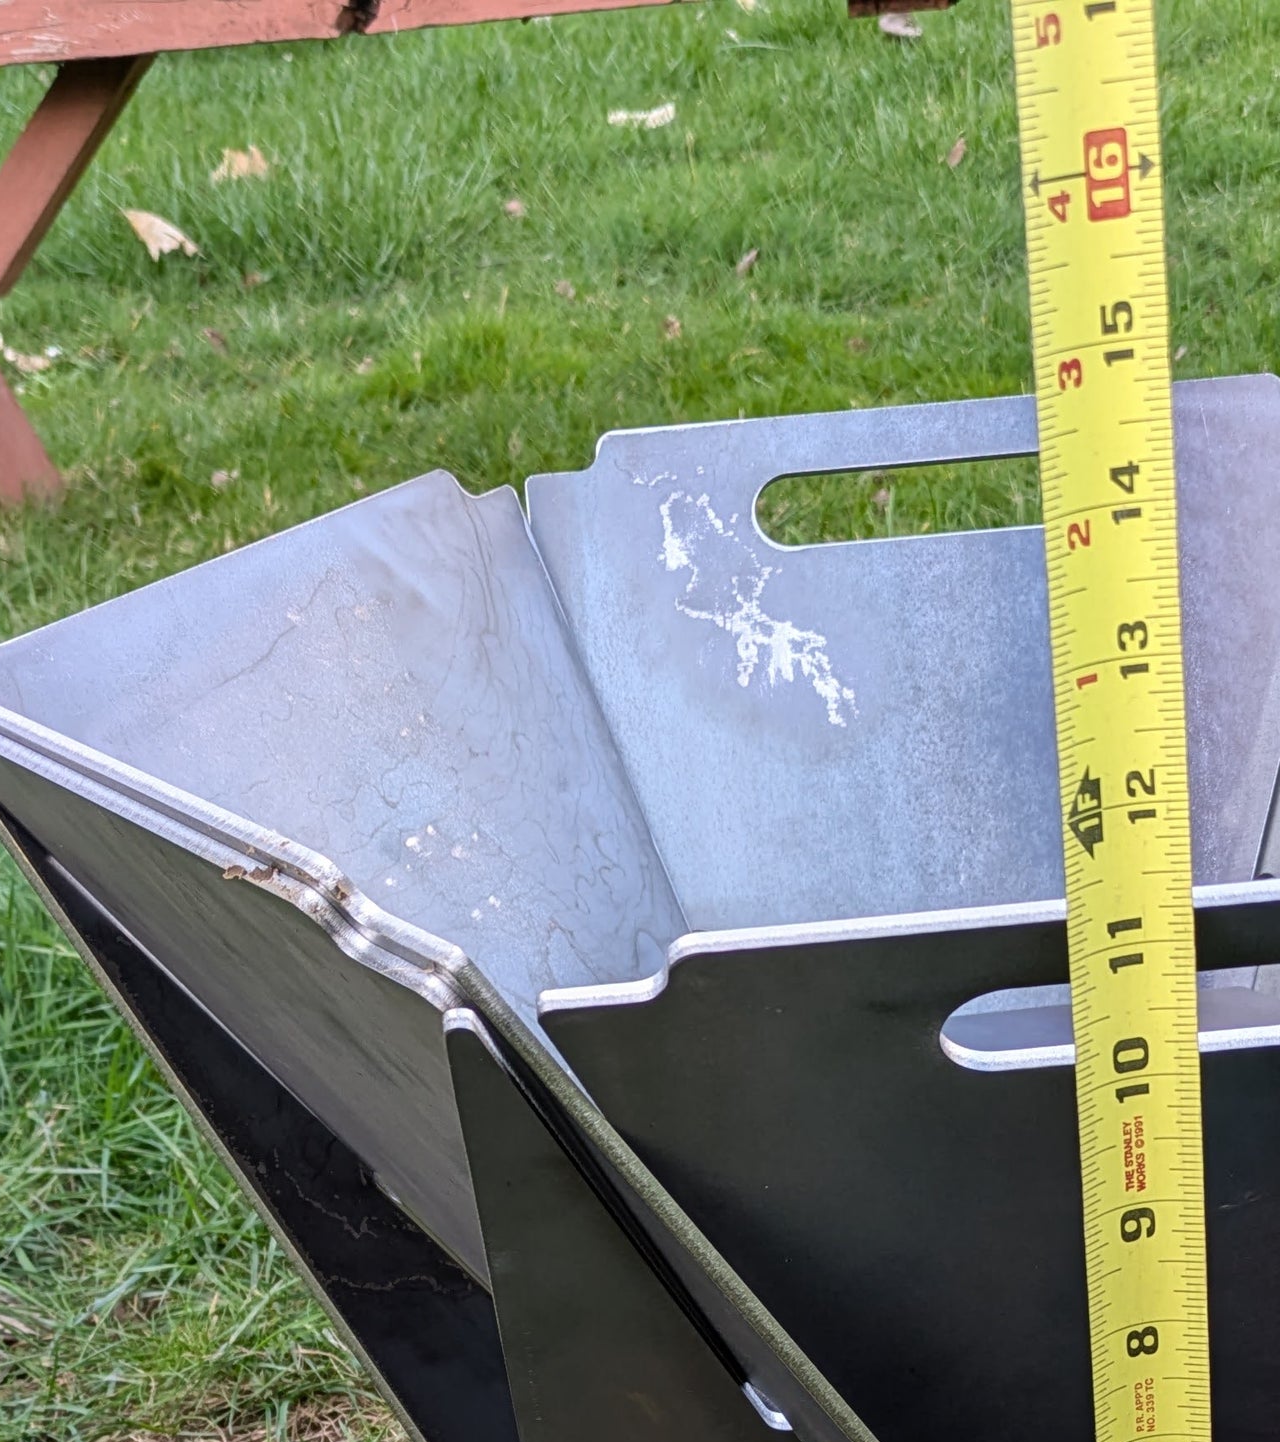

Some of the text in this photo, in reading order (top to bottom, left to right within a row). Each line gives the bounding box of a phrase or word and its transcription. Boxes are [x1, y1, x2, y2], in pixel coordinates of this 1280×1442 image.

[1035, 13, 1061, 48] 5
[1088, 141, 1125, 208] 16
[1048, 190, 1070, 223] 4
[1100, 300, 1134, 367] 15
[1058, 358, 1083, 391] 3
[1109, 460, 1142, 525] 14
[1067, 518, 1091, 550] 2
[1117, 620, 1150, 680] 13
[1076, 673, 1098, 690] 1
[1125, 768, 1157, 824] 12
[1107, 916, 1144, 974] 11
[1112, 1036, 1150, 1104] 10
[1122, 1121, 1135, 1192] THE STANLEY
[1135, 1152, 1146, 1192] WORKS
[1120, 1207, 1156, 1243] 9
[1126, 1326, 1159, 1357] 8
[1144, 1377, 1155, 1432] NO. 339 TC
